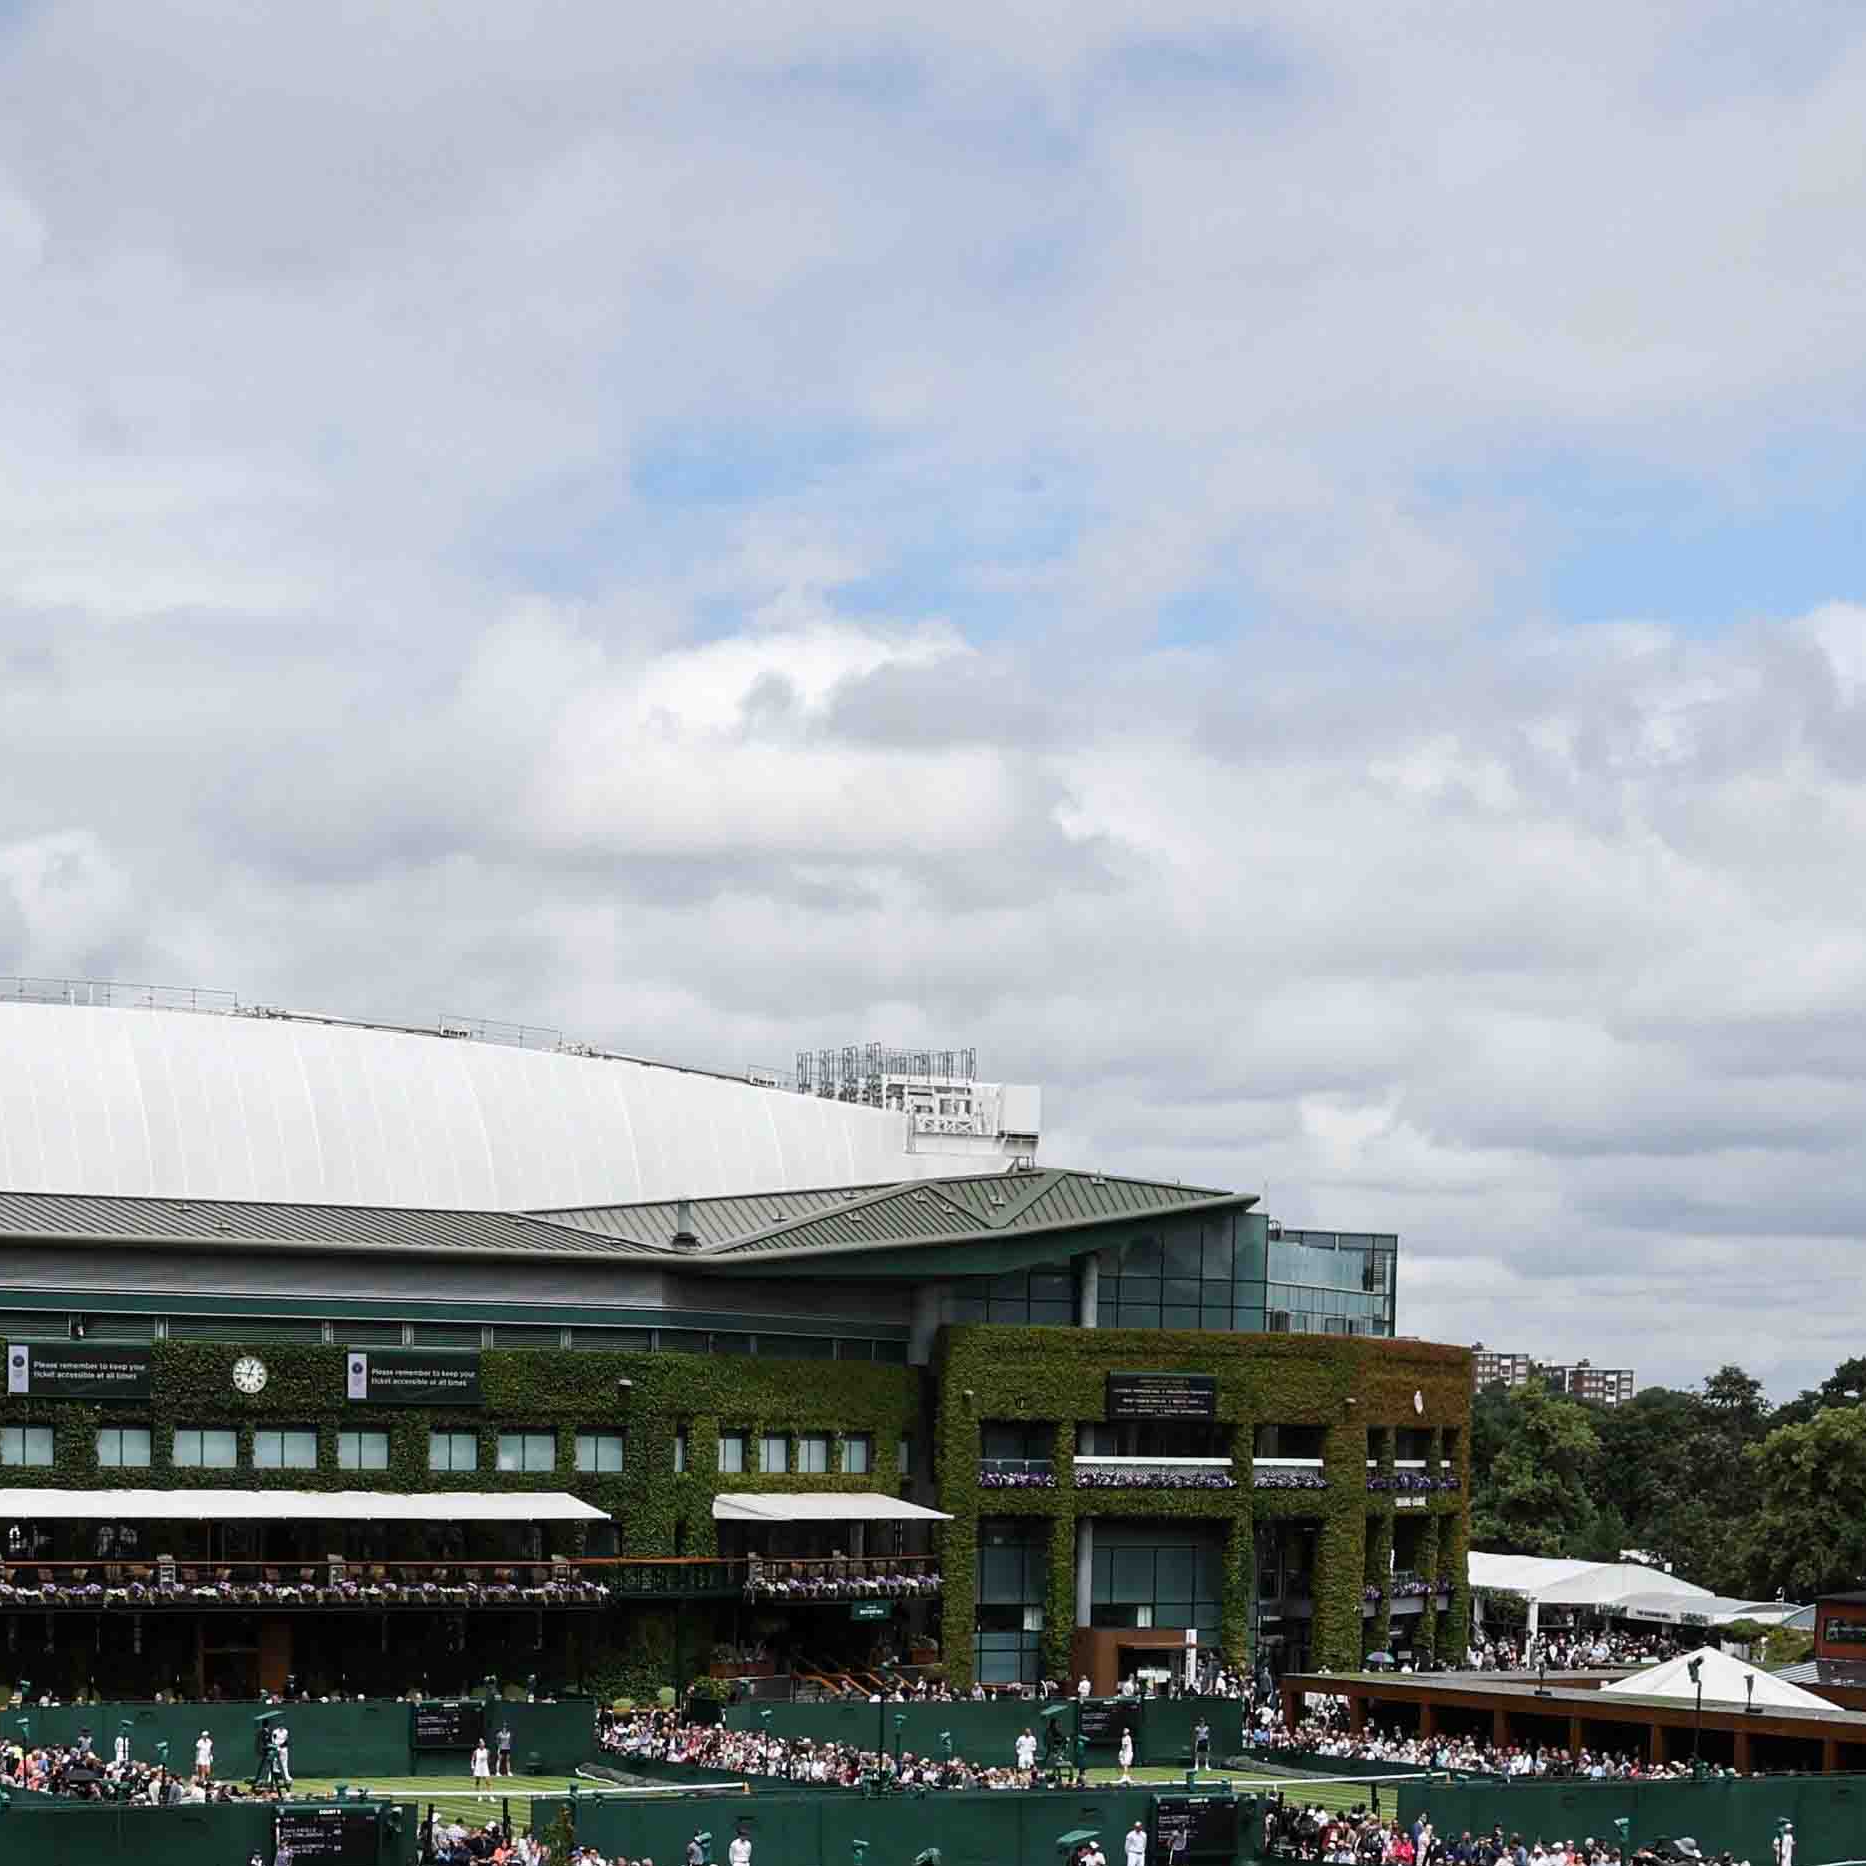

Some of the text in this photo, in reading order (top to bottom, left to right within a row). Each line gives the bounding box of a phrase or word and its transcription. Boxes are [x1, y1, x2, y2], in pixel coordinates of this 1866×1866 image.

[34, 1361, 57, 1369] Please
[109, 1364, 127, 1372] keep
[57, 1371, 95, 1379] accessible
[372, 1368, 393, 1376] Please
[395, 1369, 431, 1377] remember
[441, 1370, 459, 1378] keep
